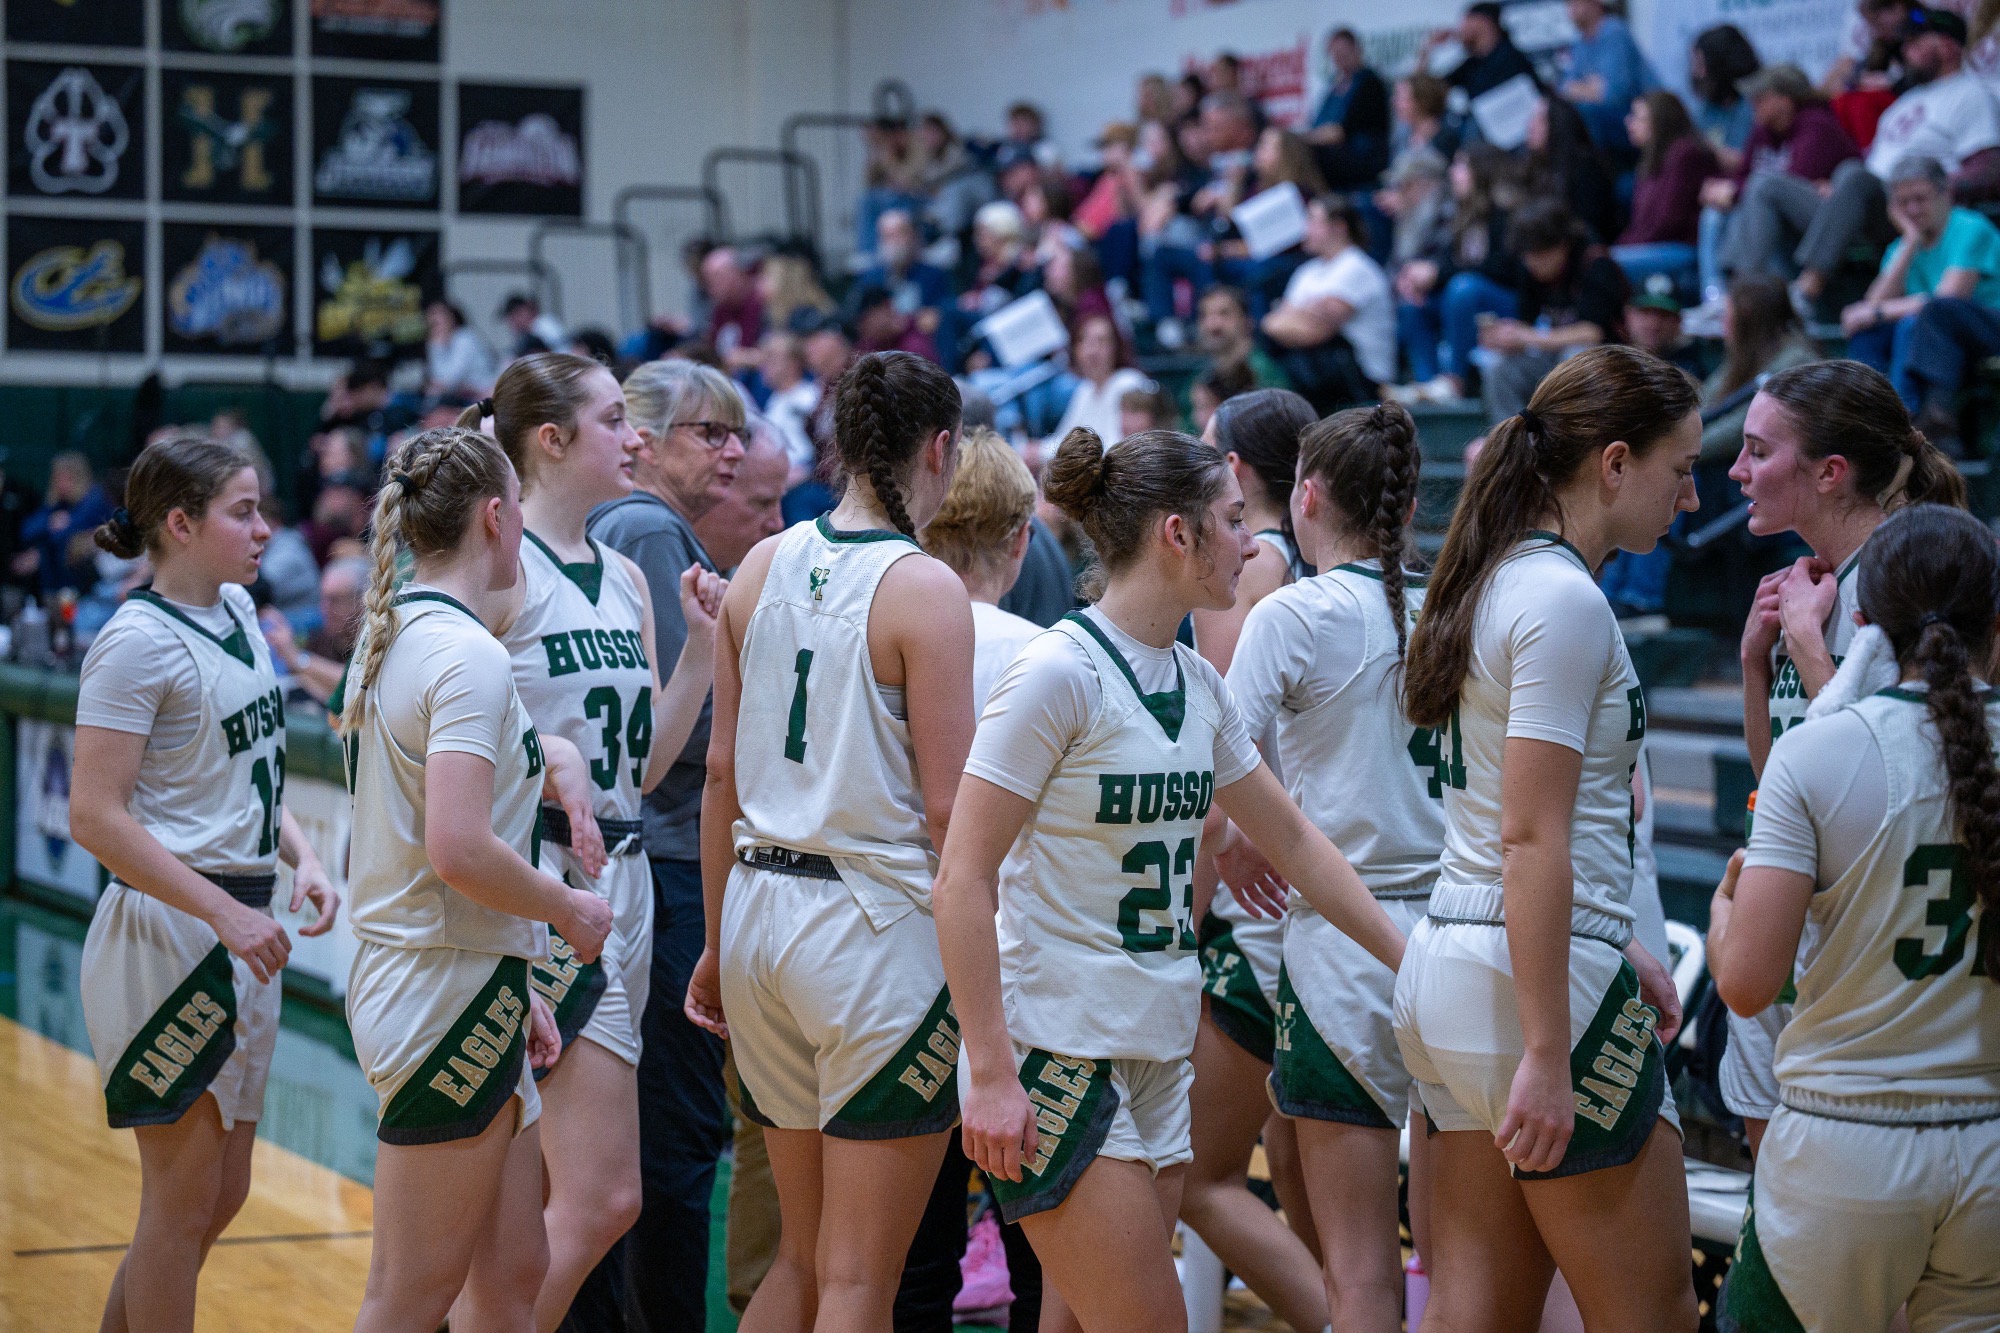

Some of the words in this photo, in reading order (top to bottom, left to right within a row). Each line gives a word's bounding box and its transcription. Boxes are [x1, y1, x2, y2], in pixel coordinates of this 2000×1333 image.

[583, 686, 653, 791] 34
[784, 648, 814, 764] 1
[251, 746, 286, 858] 12
[1117, 837, 1198, 954] 23
[129, 991, 228, 1098] EAGLES
[429, 986, 524, 1107] EAGLES
[898, 1001, 963, 1103] EAGL
[1573, 998, 1657, 1131] EAGLES
